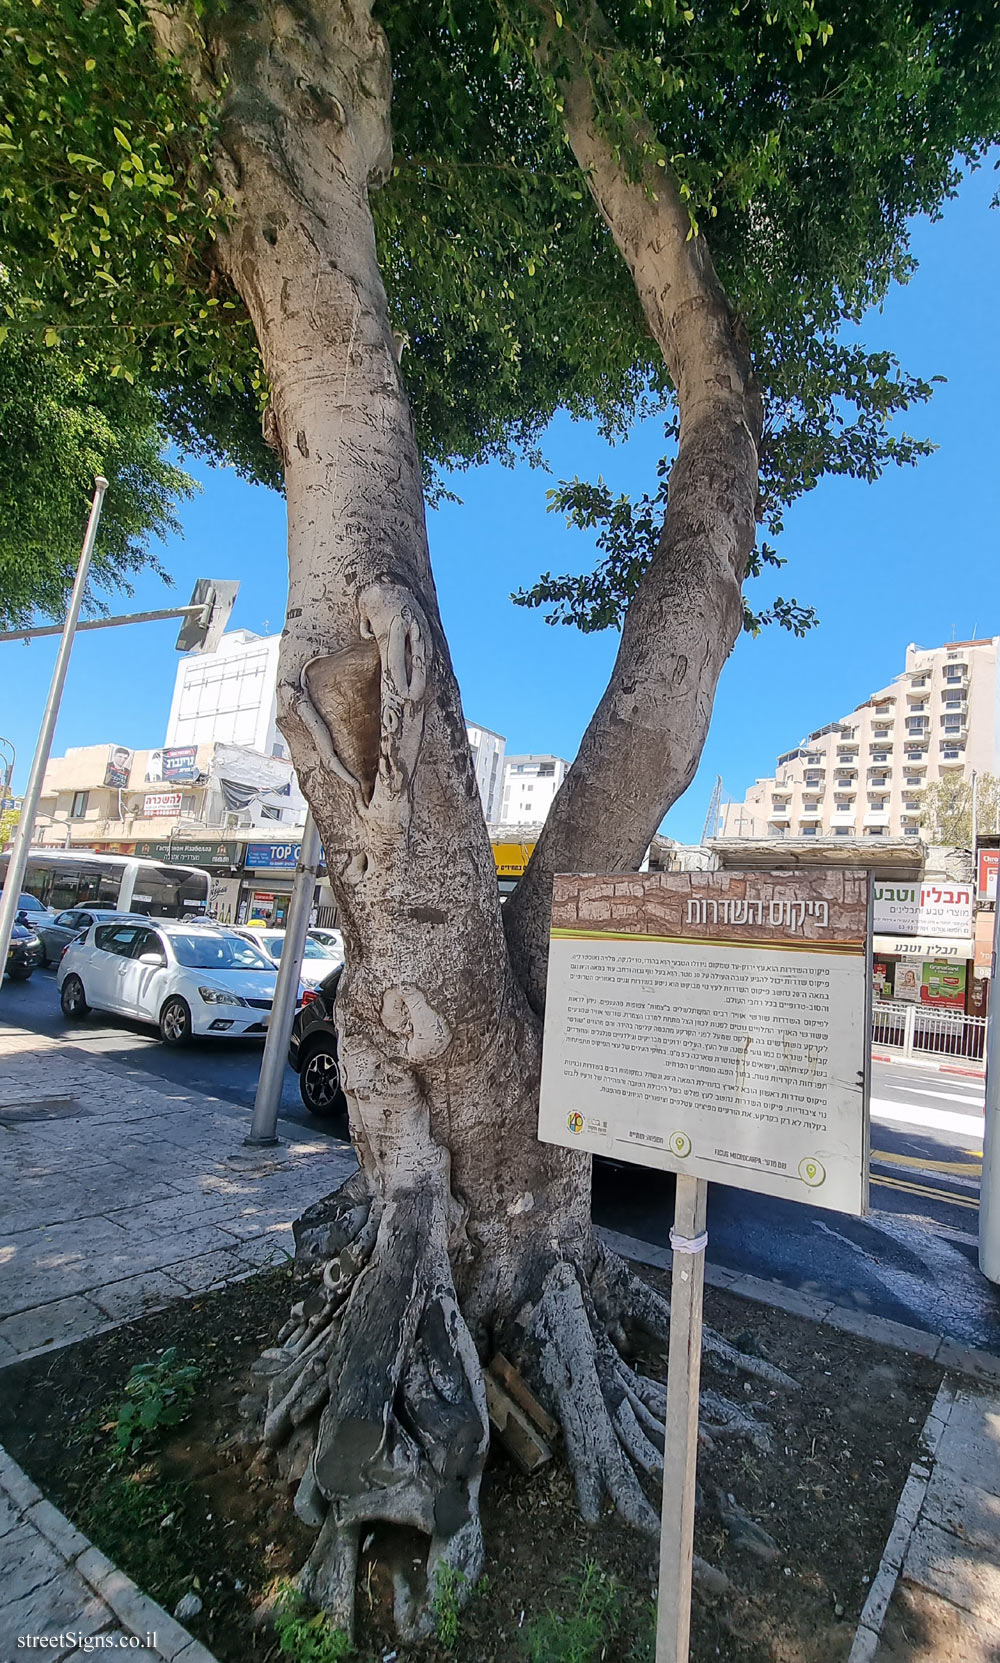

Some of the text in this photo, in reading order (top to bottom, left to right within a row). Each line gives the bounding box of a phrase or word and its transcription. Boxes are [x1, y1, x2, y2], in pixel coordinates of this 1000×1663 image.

[146, 792, 181, 804] להשכרה
[270, 846, 292, 860] TOP
[874, 887, 970, 907] תבלין וטבע
[685, 897, 830, 931] פיקוס השדרות
[890, 905, 970, 918] מוצרי טבע ותבלינים
[893, 943, 958, 955] תבלין וטבע
